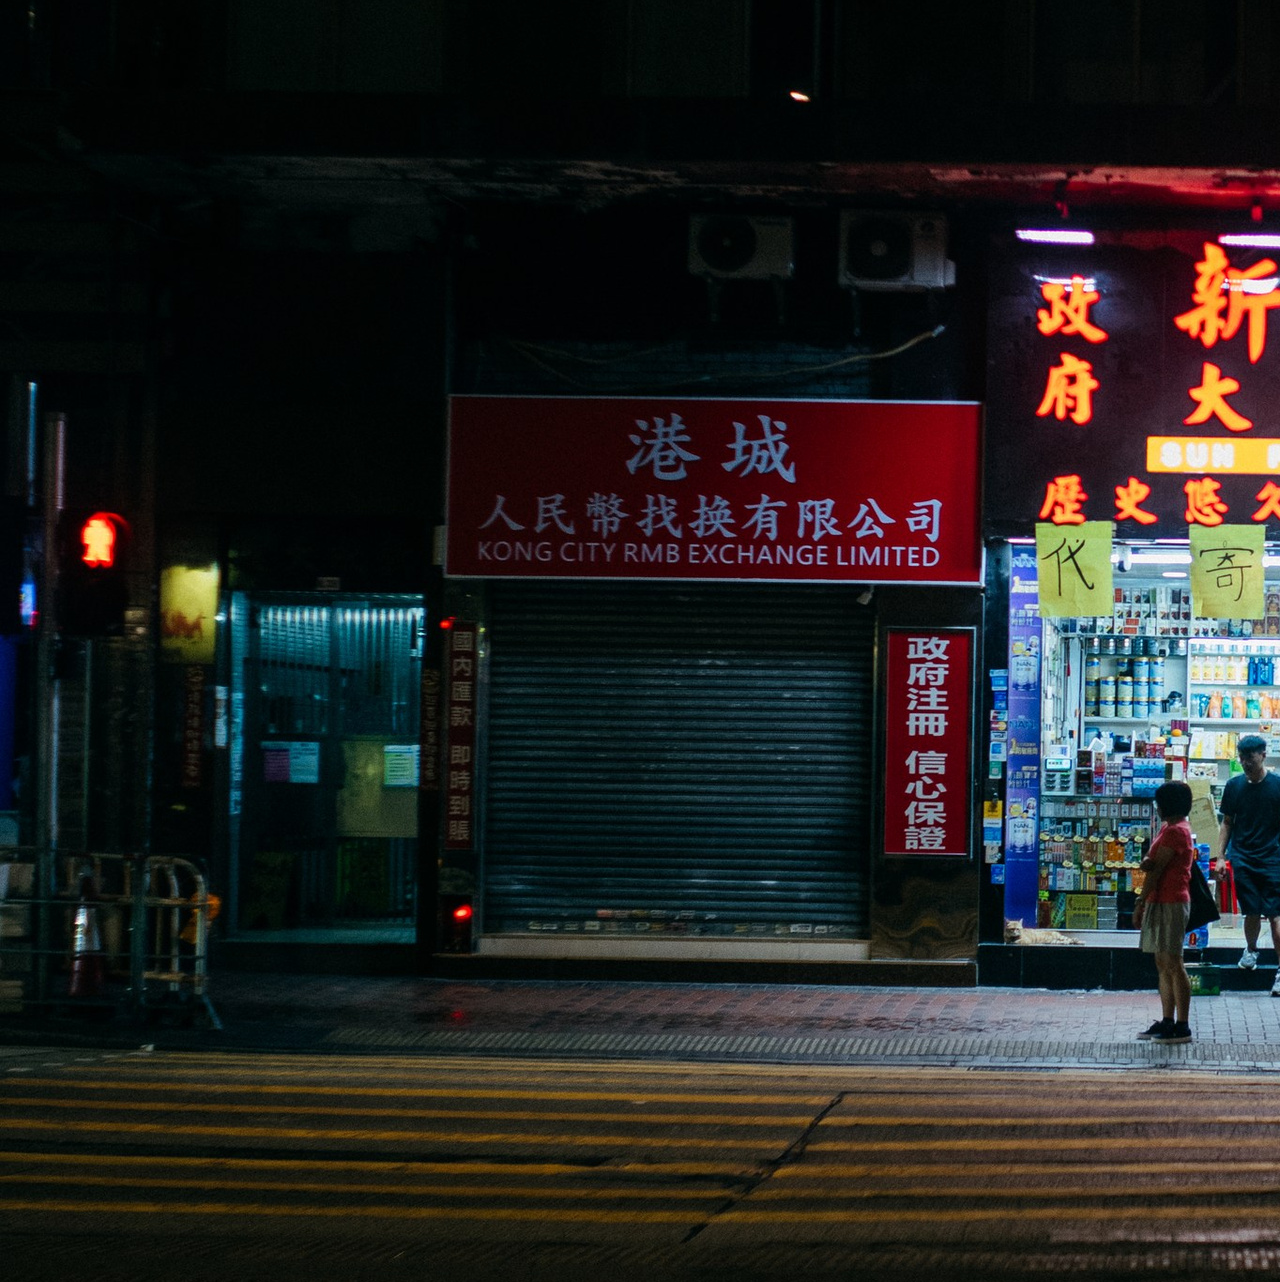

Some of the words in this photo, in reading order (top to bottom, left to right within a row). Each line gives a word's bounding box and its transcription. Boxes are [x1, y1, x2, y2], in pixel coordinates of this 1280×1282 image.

[1036, 276, 1108, 425] 政府
[625, 413, 797, 484] 港城
[1160, 442, 1235, 469] SUN
[478, 541, 552, 563] KONG
[559, 542, 616, 563] CITY
[623, 543, 681, 564] RMB
[688, 544, 829, 566] EXCHANGE
[836, 546, 940, 568] LIMITED
